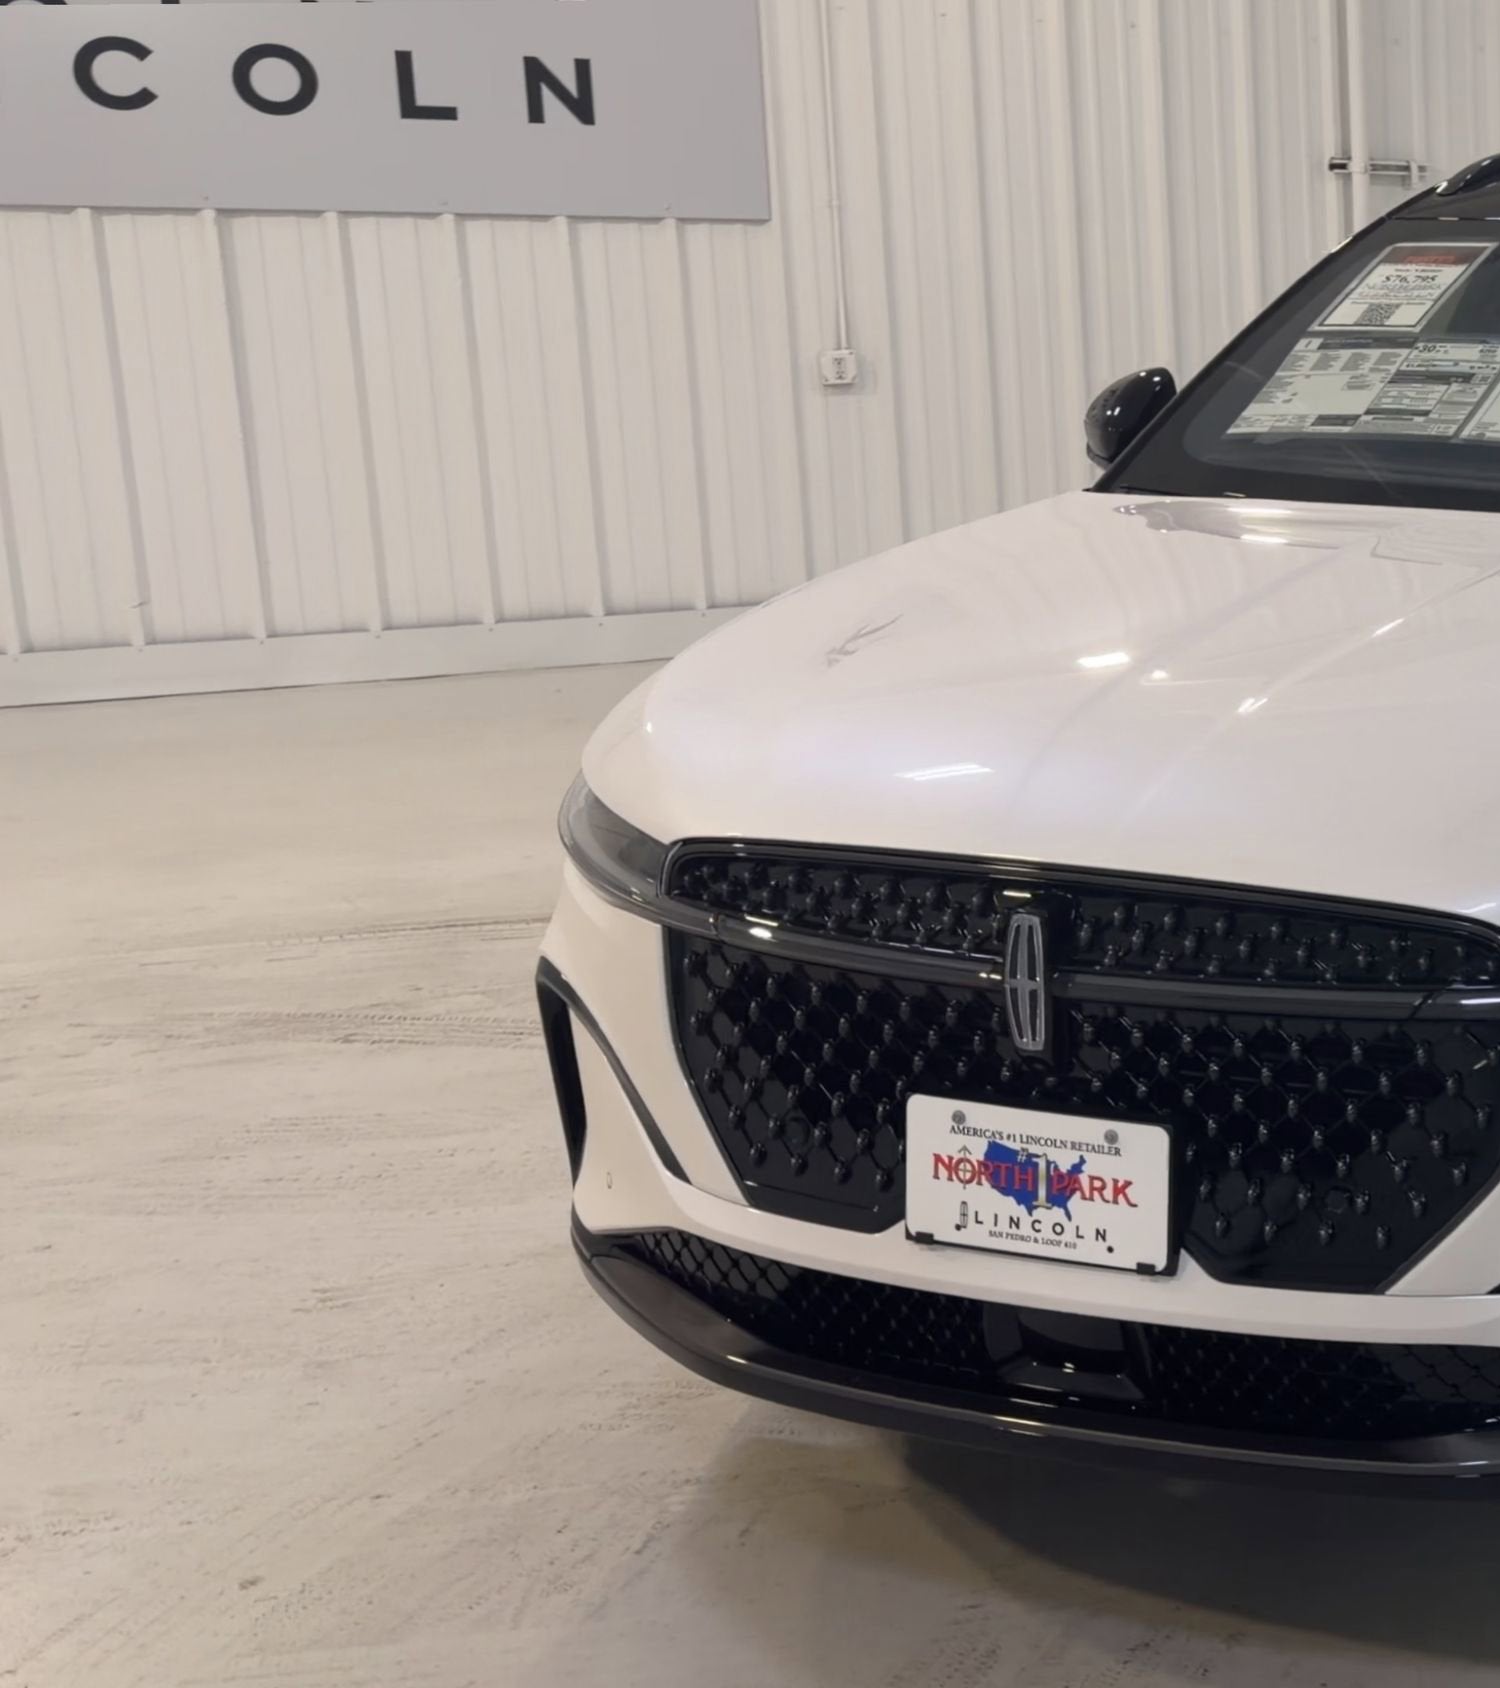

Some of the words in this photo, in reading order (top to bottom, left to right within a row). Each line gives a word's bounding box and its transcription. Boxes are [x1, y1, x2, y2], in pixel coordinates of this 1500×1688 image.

[950, 1125, 1004, 1141] AMERICA'S
[1006, 1132, 1017, 1143] #1
[1020, 1134, 1069, 1149] LINCOLN
[1071, 1142, 1122, 1157] RETAILER
[931, 1153, 1035, 1192] NORTH
[1051, 1166, 1138, 1208] PARK
[974, 1210, 1107, 1242] LINCOLN
[988, 1230, 1005, 1239] SAN
[1005, 1231, 1032, 1243] PEDRO
